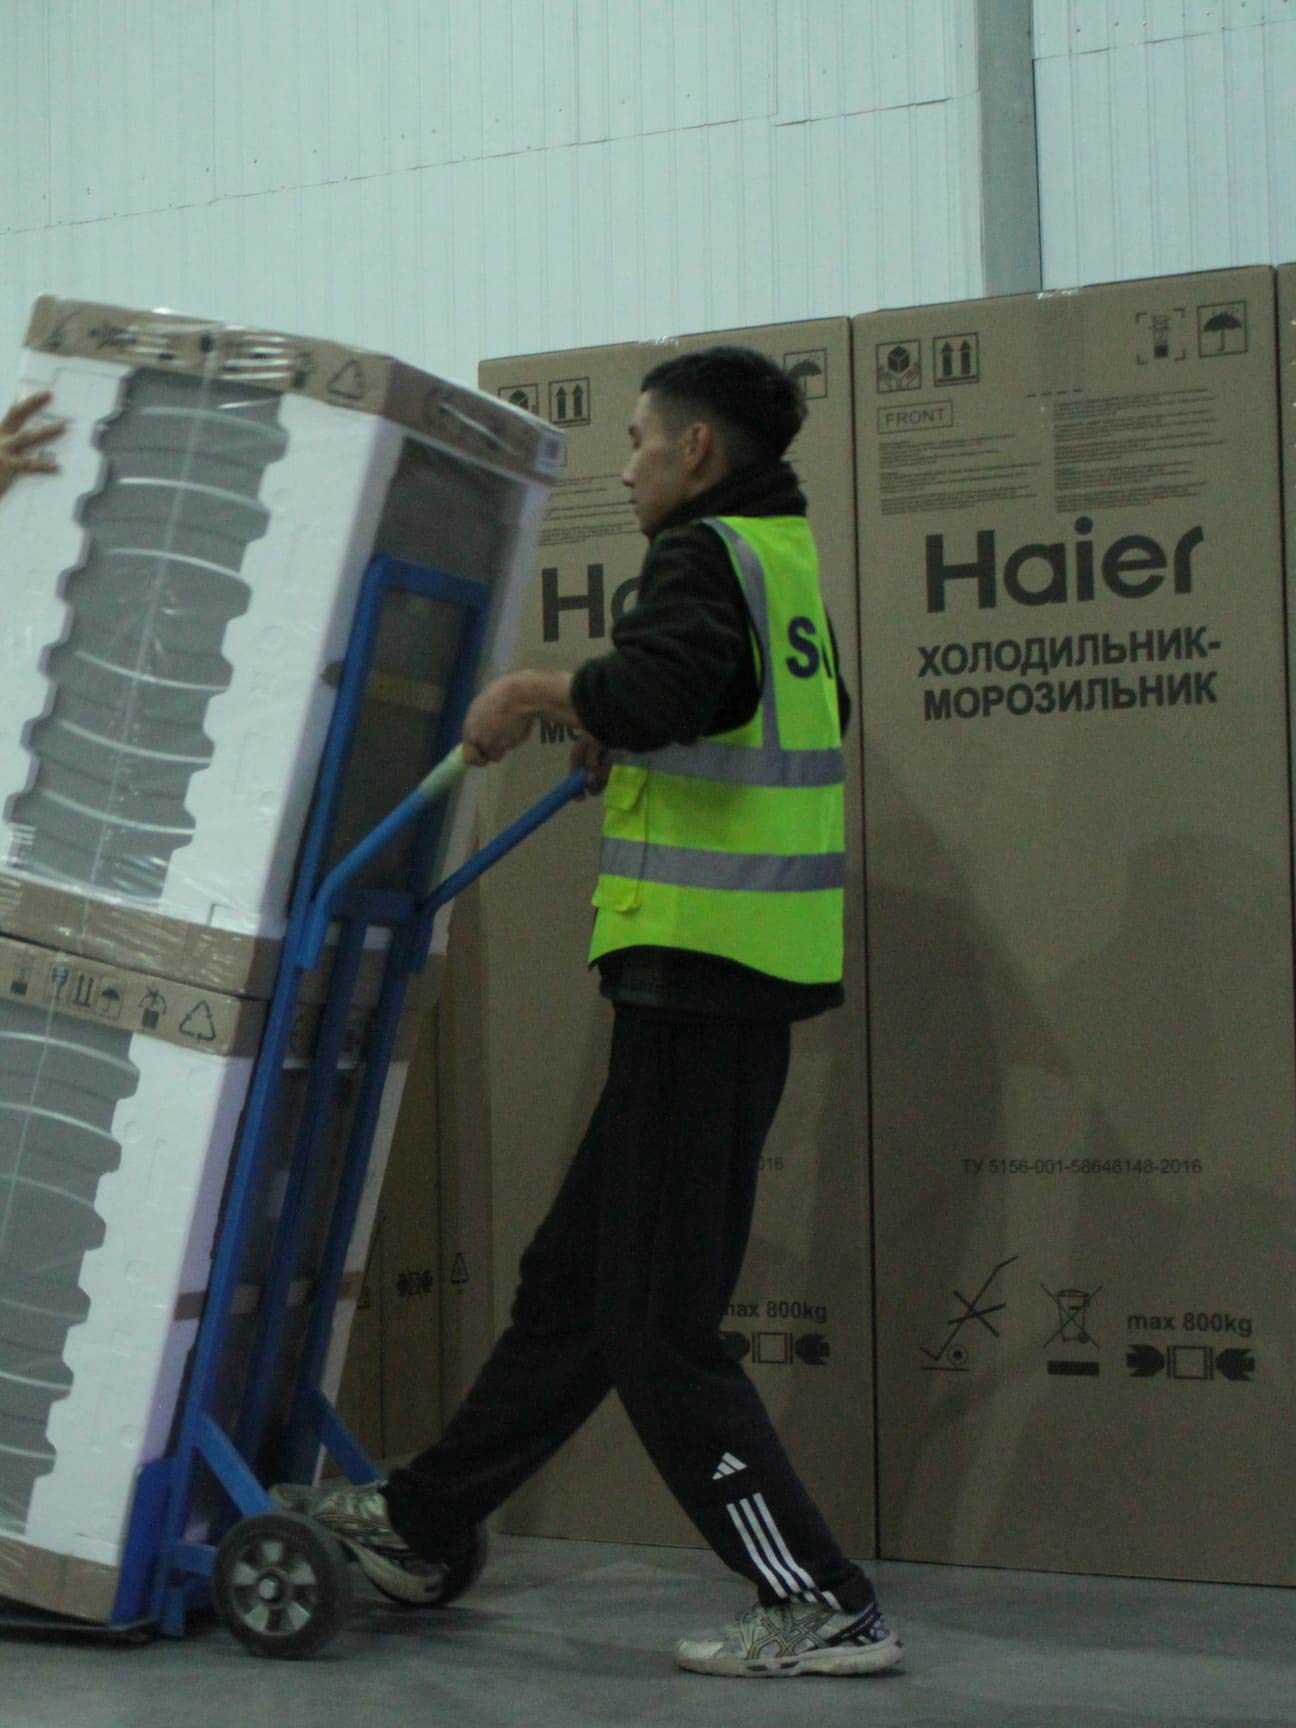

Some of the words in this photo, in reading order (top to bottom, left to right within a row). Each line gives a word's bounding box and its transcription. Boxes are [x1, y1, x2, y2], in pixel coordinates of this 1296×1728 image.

[884, 408, 946, 428] FRONT
[926, 516, 1204, 614] Haier
[786, 615, 832, 679] S
[918, 625, 1221, 677] ХОЛОДИЛЬНИК-
[924, 671, 1218, 721] МОРОЗИЛЬНИК
[988, 1159, 1203, 1175] 5156-001-58648148-2016
[766, 1301, 827, 1325] 800kg
[1127, 1314, 1176, 1331] max
[1183, 1311, 1253, 1338] 800kg
